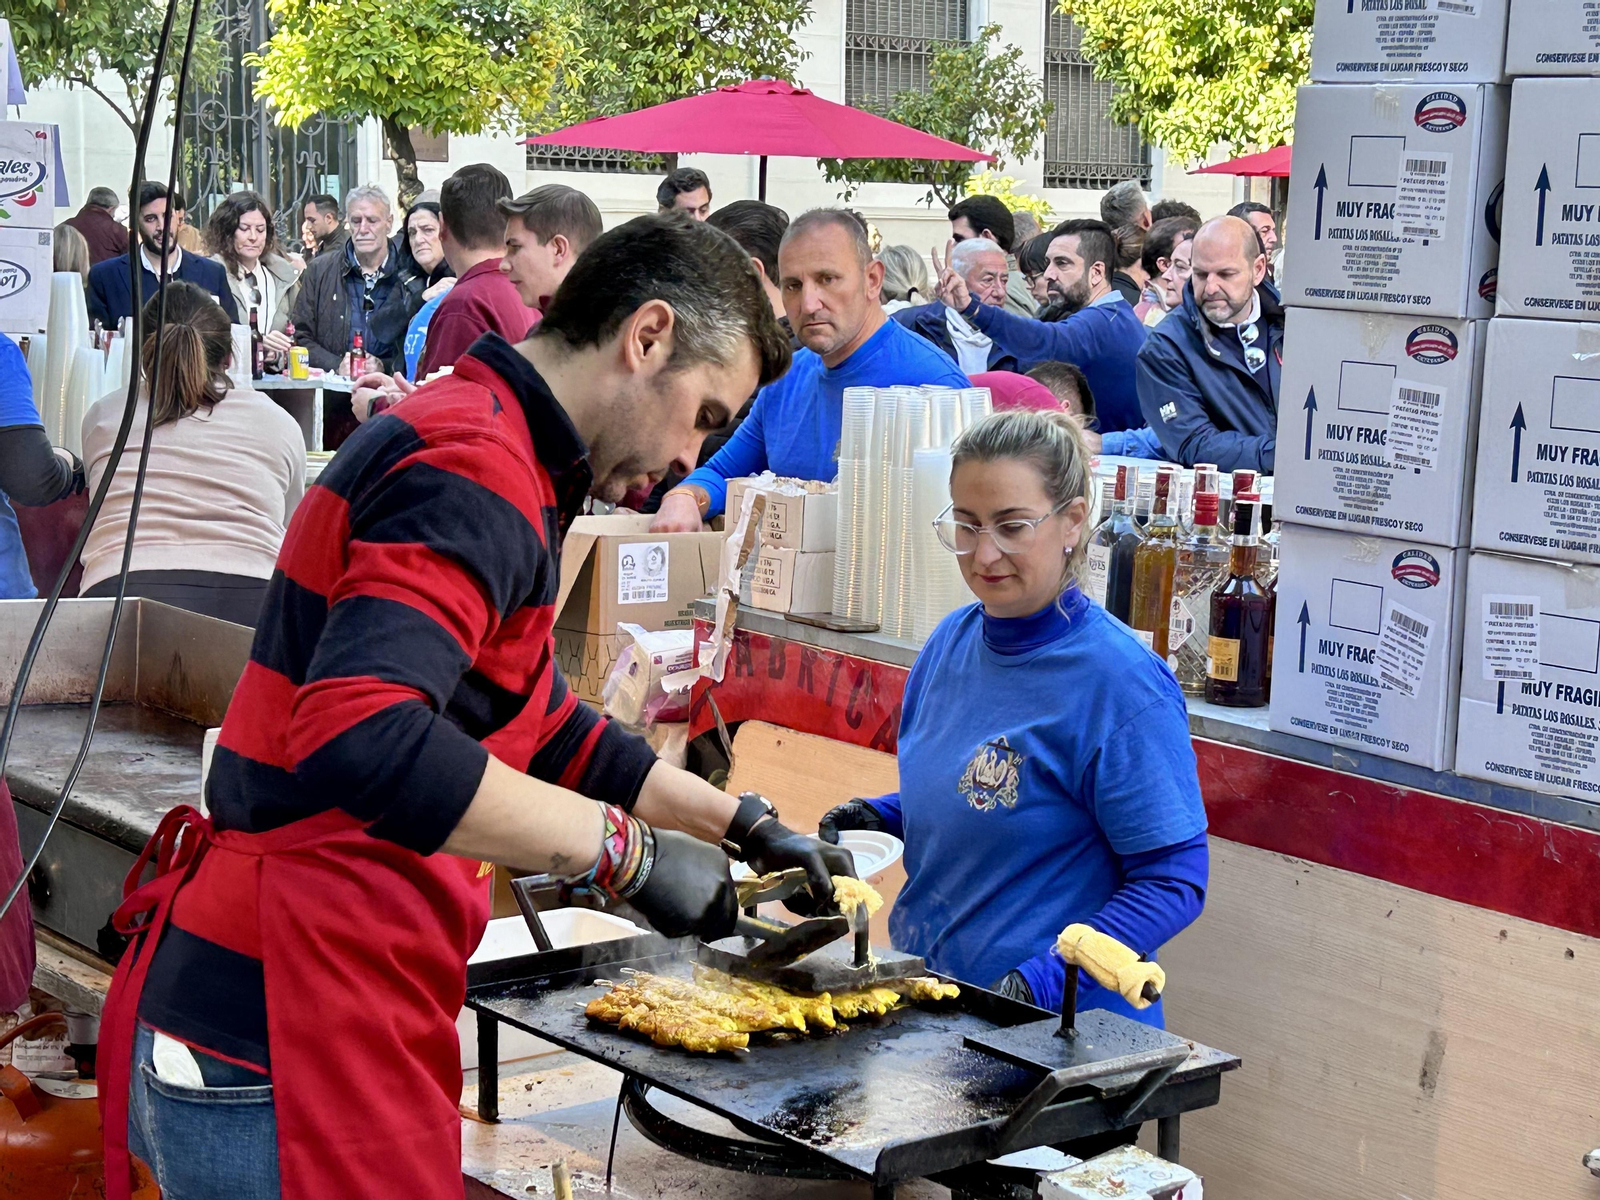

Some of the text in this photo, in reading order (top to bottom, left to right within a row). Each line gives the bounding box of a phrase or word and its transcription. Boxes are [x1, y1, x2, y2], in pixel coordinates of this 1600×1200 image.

[1336, 62, 1469, 73] CONSERVESE EN LUGAR FRESCO Y SECO
[1536, 53, 1600, 64] CONSERVESE EN
[1426, 91, 1458, 103] CALIDAD
[1336, 201, 1364, 218] MUY
[1562, 204, 1594, 222] MUY
[1328, 228, 1354, 240] PATATAS
[1356, 229, 1368, 242] LOS
[1552, 233, 1584, 246] PATATAS
[1304, 288, 1346, 300] CONSERVESE
[1357, 291, 1378, 302] LUGAR
[1380, 292, 1406, 304] FRESCO
[1406, 294, 1412, 304] Y
[1412, 295, 1432, 306] SECO
[1524, 297, 1574, 310] CONSERVESE
[1574, 300, 1586, 310] EN
[1416, 325, 1450, 337] CALIDAD
[1326, 424, 1388, 446] MUY FRAG
[1318, 448, 1344, 463] PATATAS
[1346, 452, 1360, 465] LOS
[1536, 444, 1600, 466] MUY FRA
[1526, 470, 1558, 486] PATATAS
[1559, 474, 1575, 488] LOS
[1296, 505, 1336, 520] CONSERVESE
[1348, 513, 1370, 524] LUGAR
[1371, 516, 1398, 529] FRESCO
[1398, 520, 1404, 529] Y
[1404, 520, 1424, 532] SECO
[1499, 531, 1548, 547] CONSERVESE
[1549, 538, 1560, 548] EN
[1561, 540, 1588, 552] LUGAR
[1402, 550, 1433, 562] CALIDAD
[1318, 638, 1376, 664] MUY FRAG
[1312, 663, 1336, 678] PATATAS
[1337, 668, 1349, 680] LOS
[690, 630, 901, 752] ABRICA
[1522, 680, 1552, 698] MUY
[1512, 704, 1542, 720] PATATAS
[1544, 709, 1558, 722] LOS
[1290, 716, 1328, 733] CONSERVESE
[1339, 728, 1360, 740] LUGAR
[1360, 732, 1388, 747] FRESCO
[1386, 738, 1391, 748] Y
[1391, 740, 1410, 752] SECO
[1485, 761, 1533, 778] CONSERVESE
[1534, 771, 1546, 782] EN
[1546, 774, 1572, 788] LUGAR
